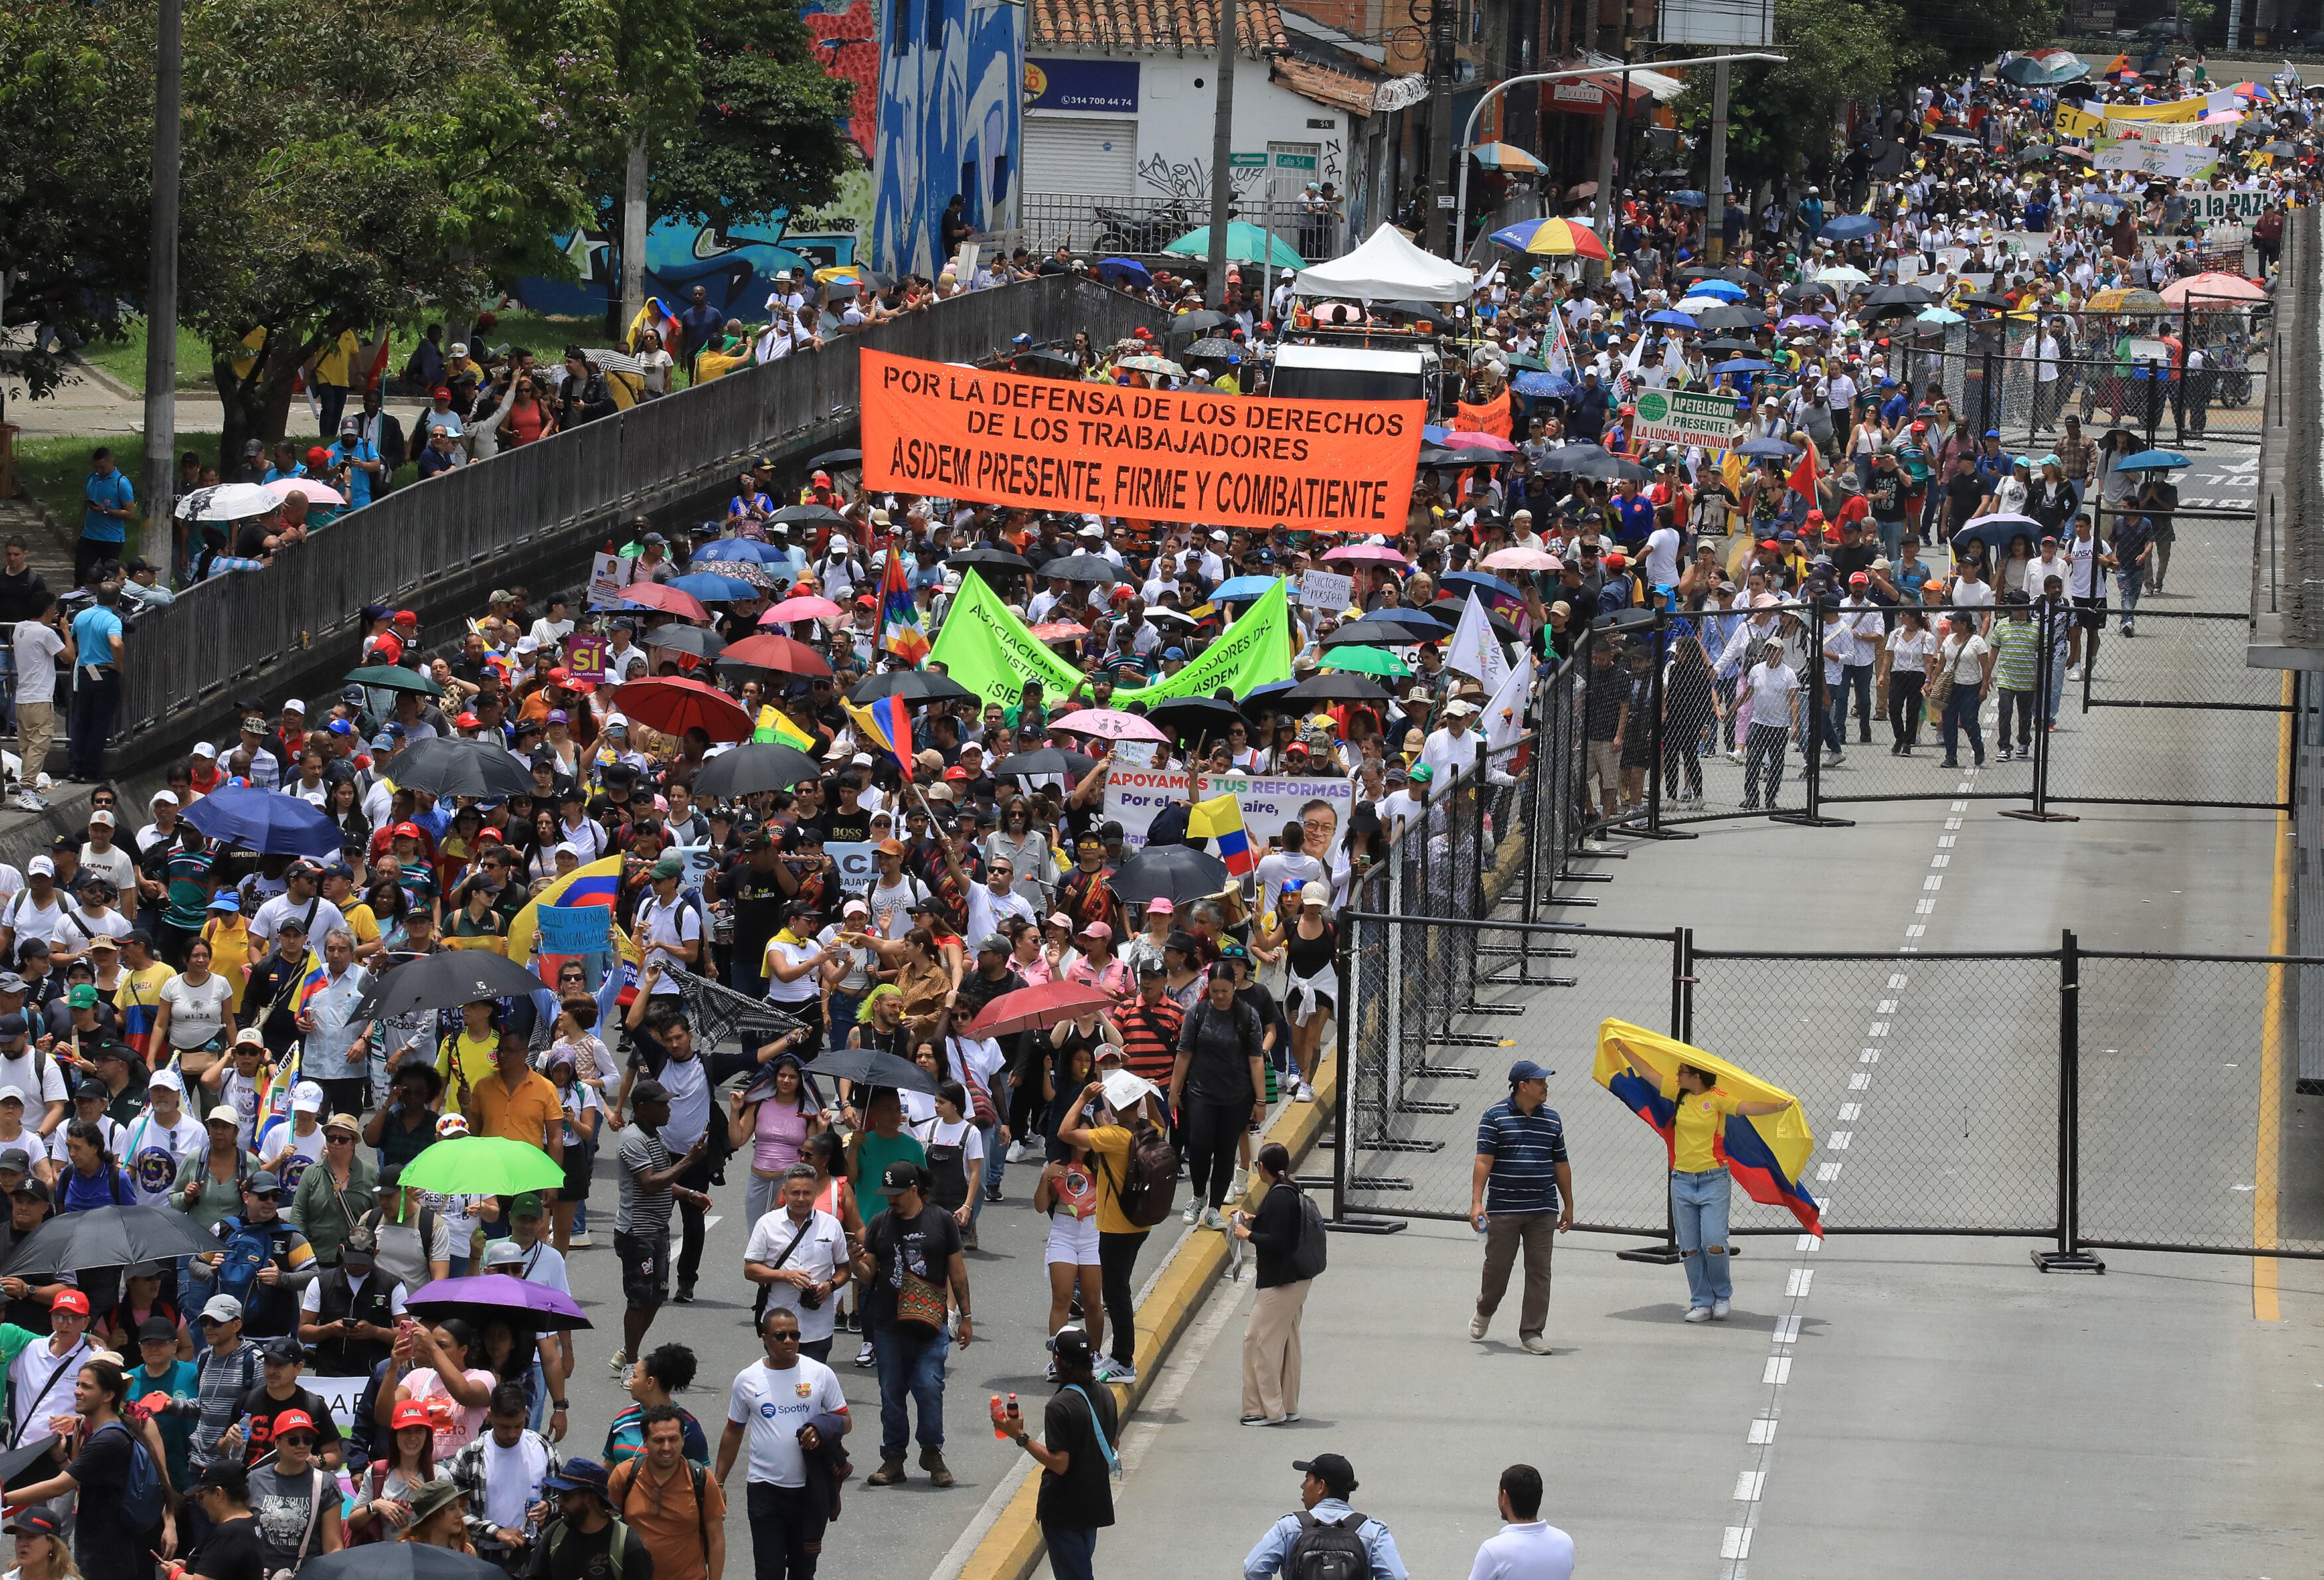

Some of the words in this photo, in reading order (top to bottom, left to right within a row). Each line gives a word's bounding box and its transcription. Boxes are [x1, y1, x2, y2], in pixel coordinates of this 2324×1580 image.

[1279, 156, 1295, 166] Calle
[1297, 157, 1305, 167] 54
[2102, 155, 2122, 165] PAZ
[2141, 158, 2165, 173] PAZ
[2206, 195, 2224, 216] la
[884, 366, 940, 398] POR
[950, 371, 985, 404] LA
[993, 382, 1125, 418] DEFENSA
[1133, 396, 1171, 421] DE
[1181, 400, 1236, 426] LOS
[1246, 406, 1403, 437] DERECHOS
[1638, 403, 1667, 412] APETELECOM
[1673, 397, 1734, 418] APETELECOM
[1673, 416, 1725, 434] PRESENTE
[967, 410, 1004, 436] DE
[1014, 416, 1068, 443] LOS
[1078, 422, 1309, 461] TRABAJADORES
[1635, 425, 1647, 437] LA
[1650, 427, 1680, 442] LUCHA
[1683, 432, 1730, 449] CONTINÚA
[890, 437, 971, 487] ASDEM
[977, 450, 1105, 511] PRESENTE,
[1115, 465, 1189, 510] FIRME
[1197, 471, 1211, 511] Y
[1217, 471, 1388, 519] COMBATIENTE
[572, 642, 603, 671] SÍ
[1213, 778, 1248, 793] TUS
[1252, 781, 1351, 797] REFORMAS
[1121, 793, 1151, 808] Por
[1243, 800, 1279, 816] aire,
[833, 827, 862, 836] BOSS
[386, 1018, 416, 1032] adidas
[778, 1401, 810, 1415] Spotify
[262, 1494, 284, 1506] FREE
[286, 1495, 310, 1509] SOULS
[267, 1532, 288, 1546] NEVER
[288, 1538, 299, 1547] DIE
